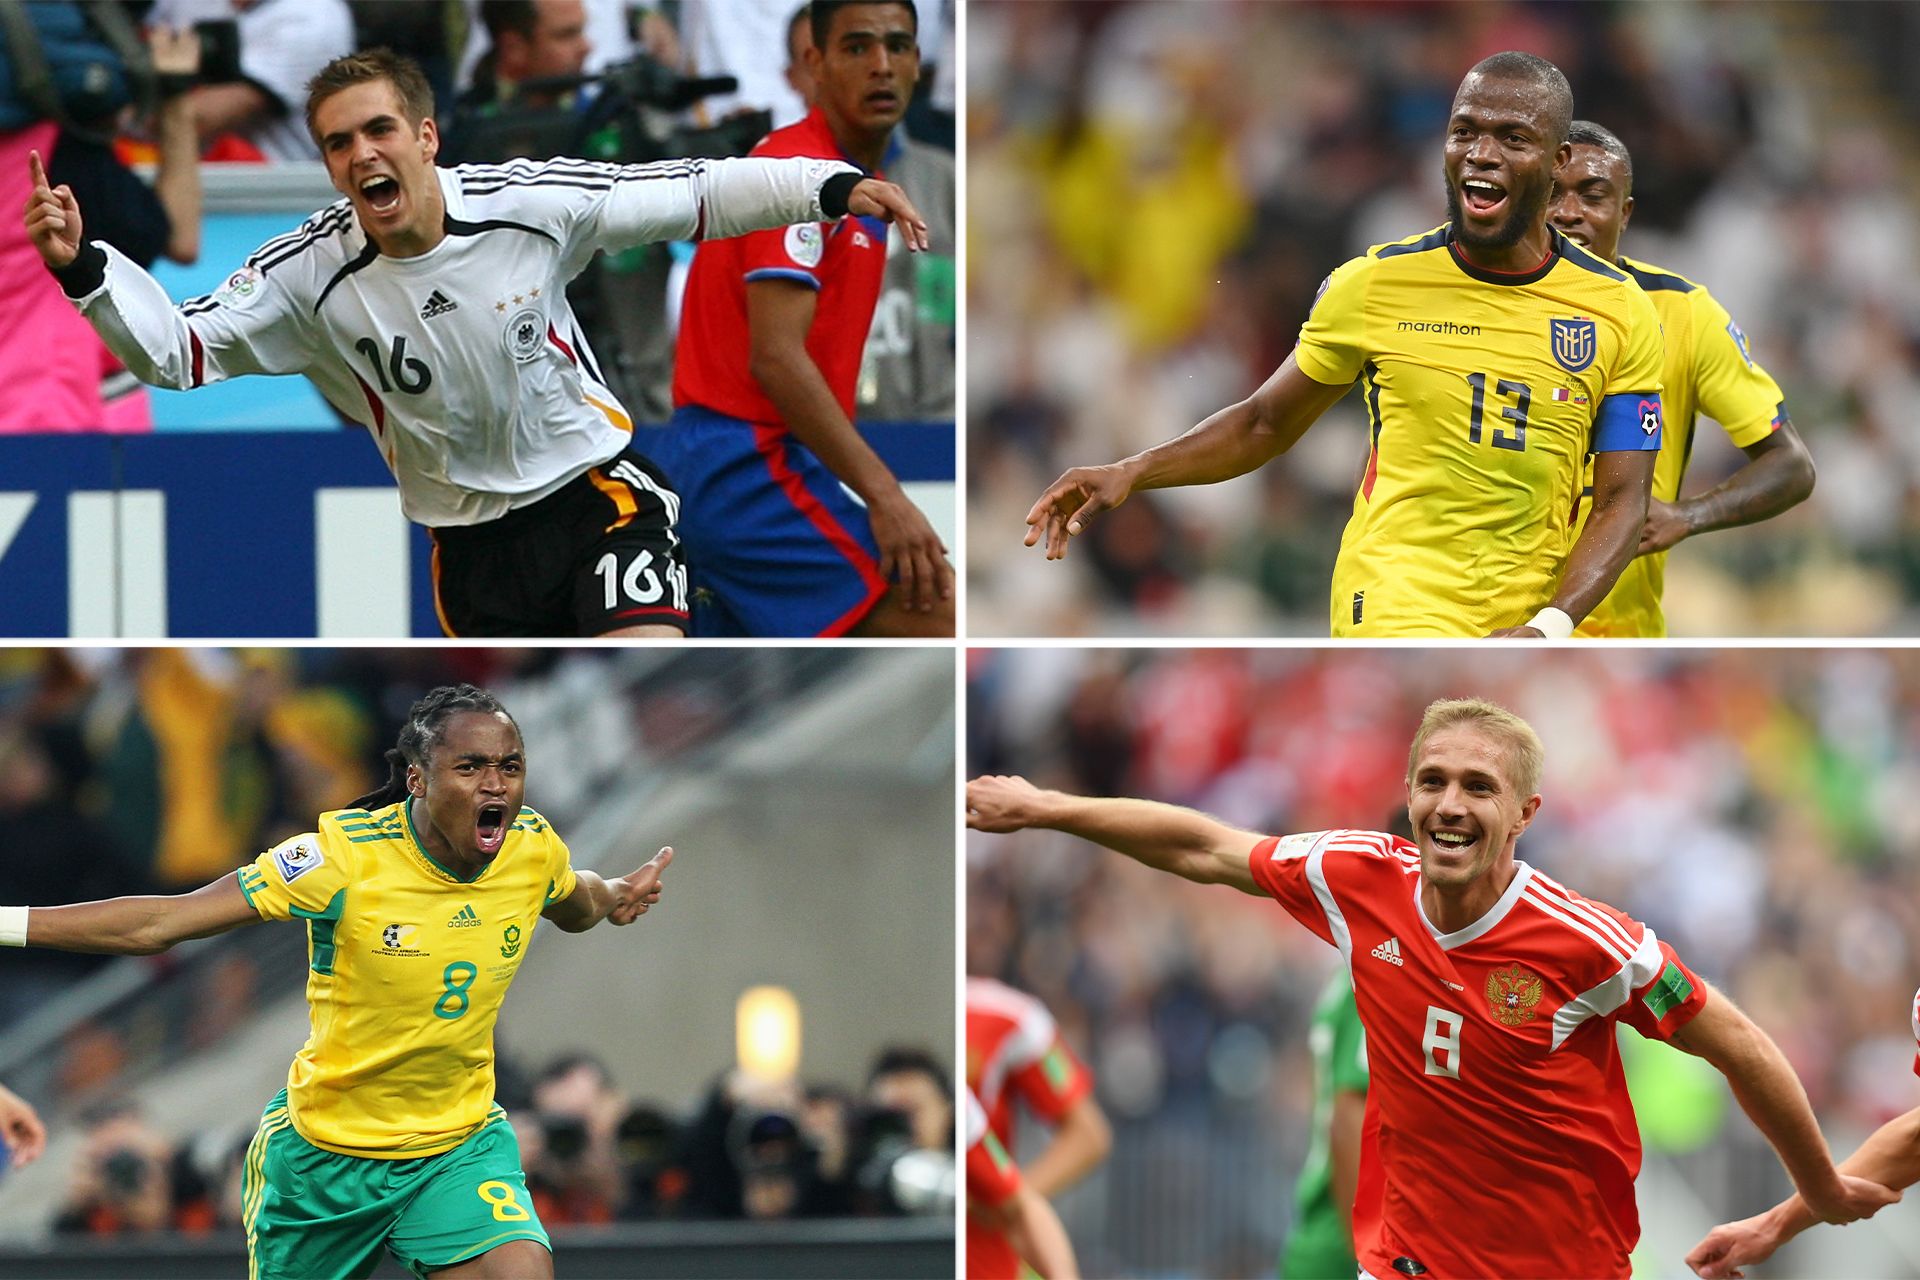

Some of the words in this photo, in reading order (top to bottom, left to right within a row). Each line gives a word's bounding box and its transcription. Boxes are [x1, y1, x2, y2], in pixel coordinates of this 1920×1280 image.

[1397, 321, 1481, 336] marathon
[355, 335, 432, 395] 16
[1466, 372, 1532, 452] 13
[594, 549, 664, 610] 16
[447, 918, 482, 928] adidas
[1371, 948, 1404, 967] adidas
[433, 961, 477, 1020] 8
[1422, 1005, 1464, 1081] 8
[477, 1180, 531, 1222] 8
